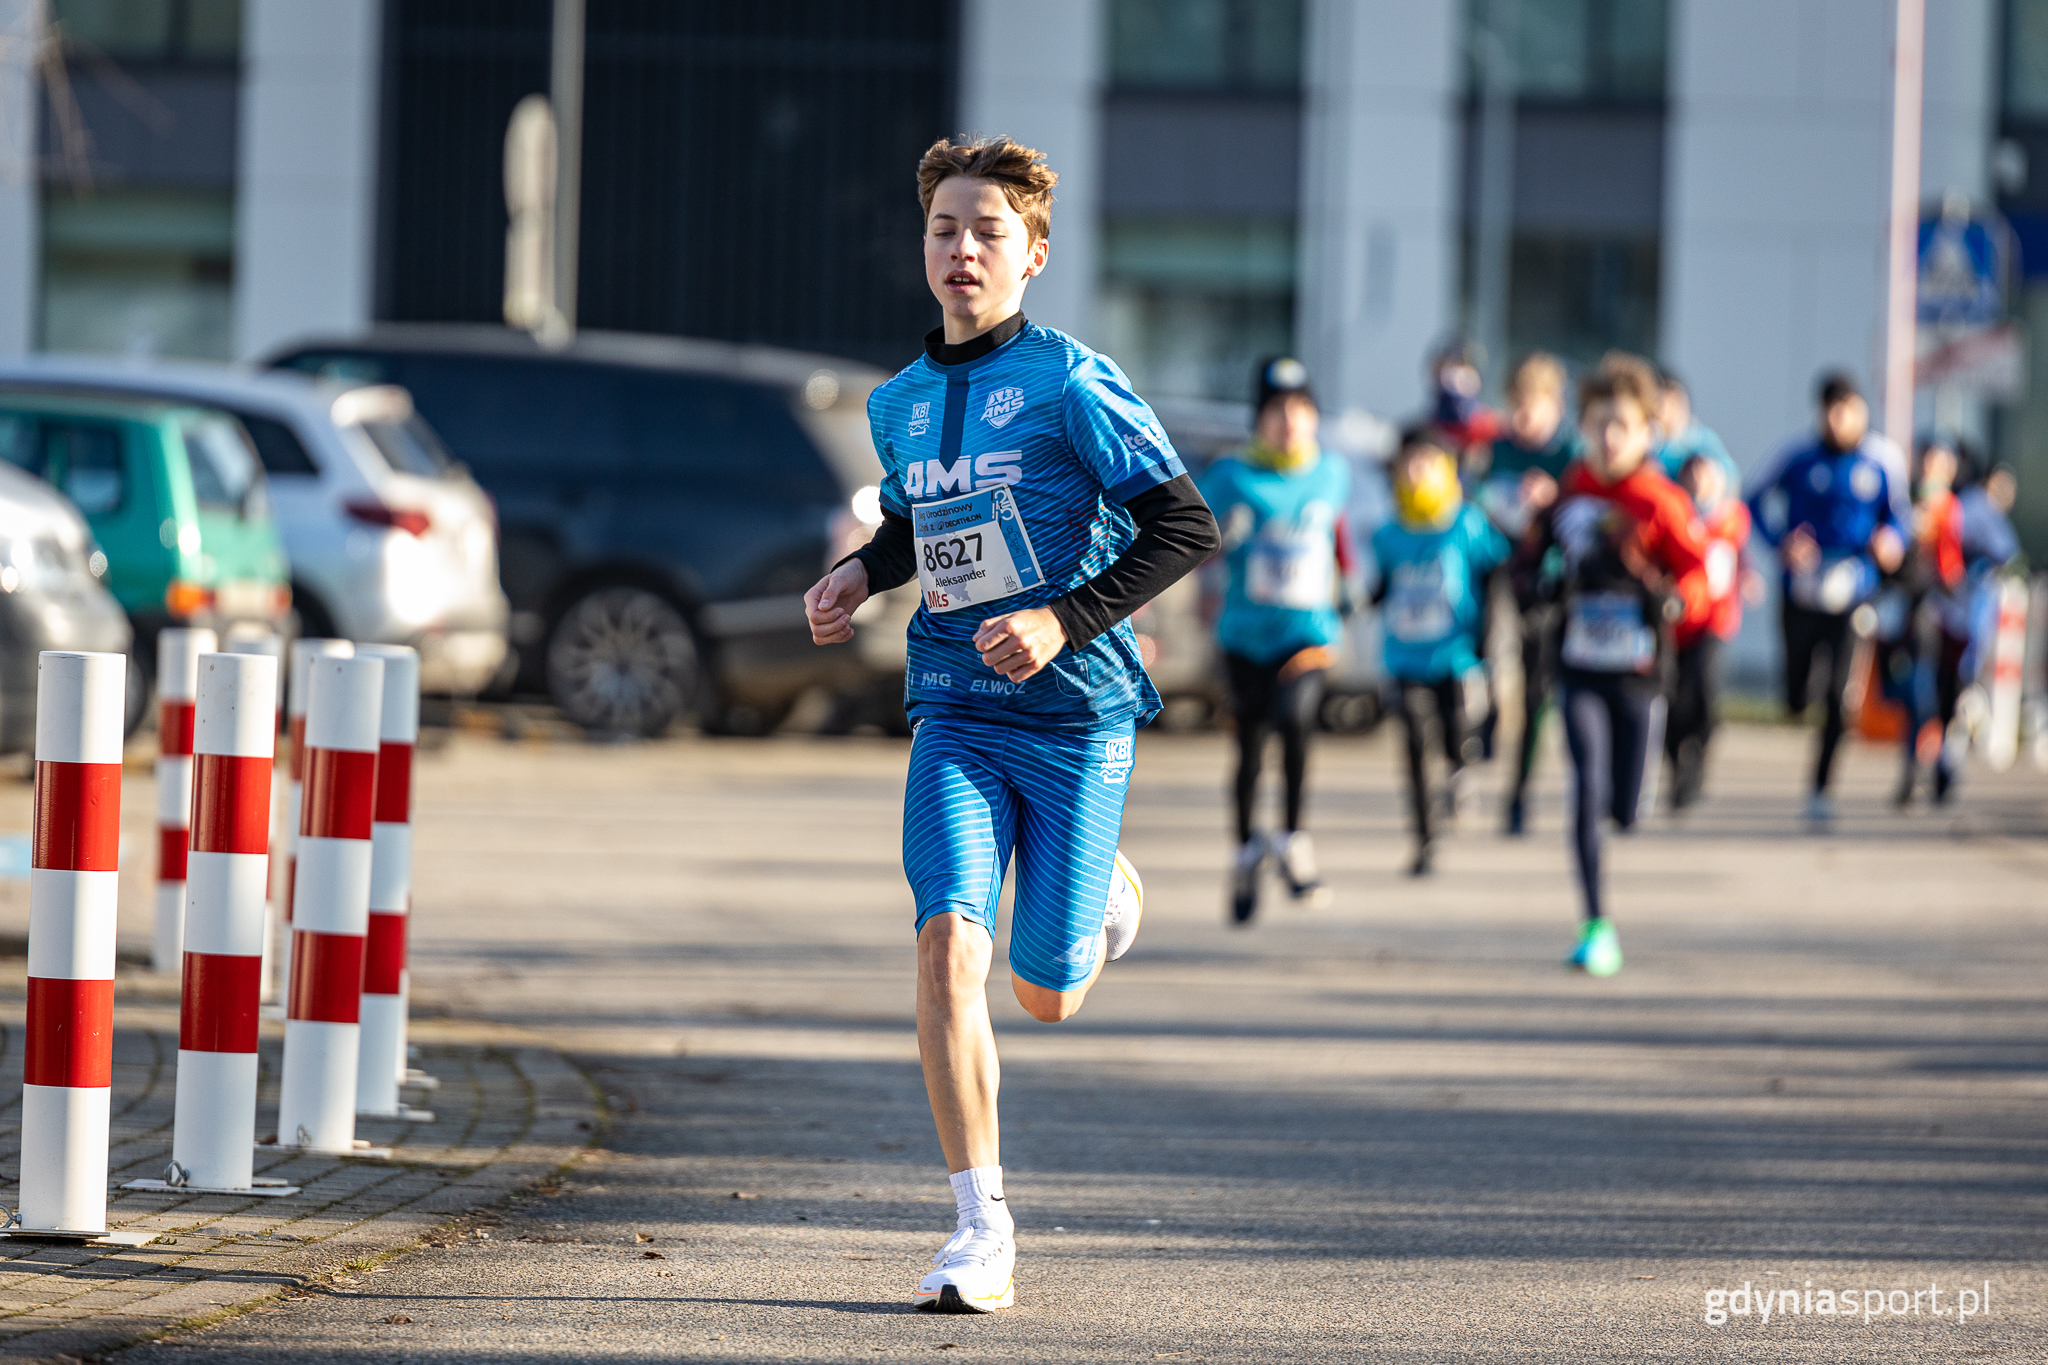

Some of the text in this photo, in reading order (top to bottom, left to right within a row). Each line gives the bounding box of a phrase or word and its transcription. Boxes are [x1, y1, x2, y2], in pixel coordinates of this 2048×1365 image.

[980, 396, 1025, 421] AMS
[904, 450, 1022, 498] AMS
[926, 502, 973, 519] Urodzinowy
[945, 513, 983, 528] DECATHLON
[923, 532, 983, 572] 8627
[935, 569, 986, 588] Aleksander
[921, 672, 952, 687] MG
[970, 680, 1026, 695] ELWOZ
